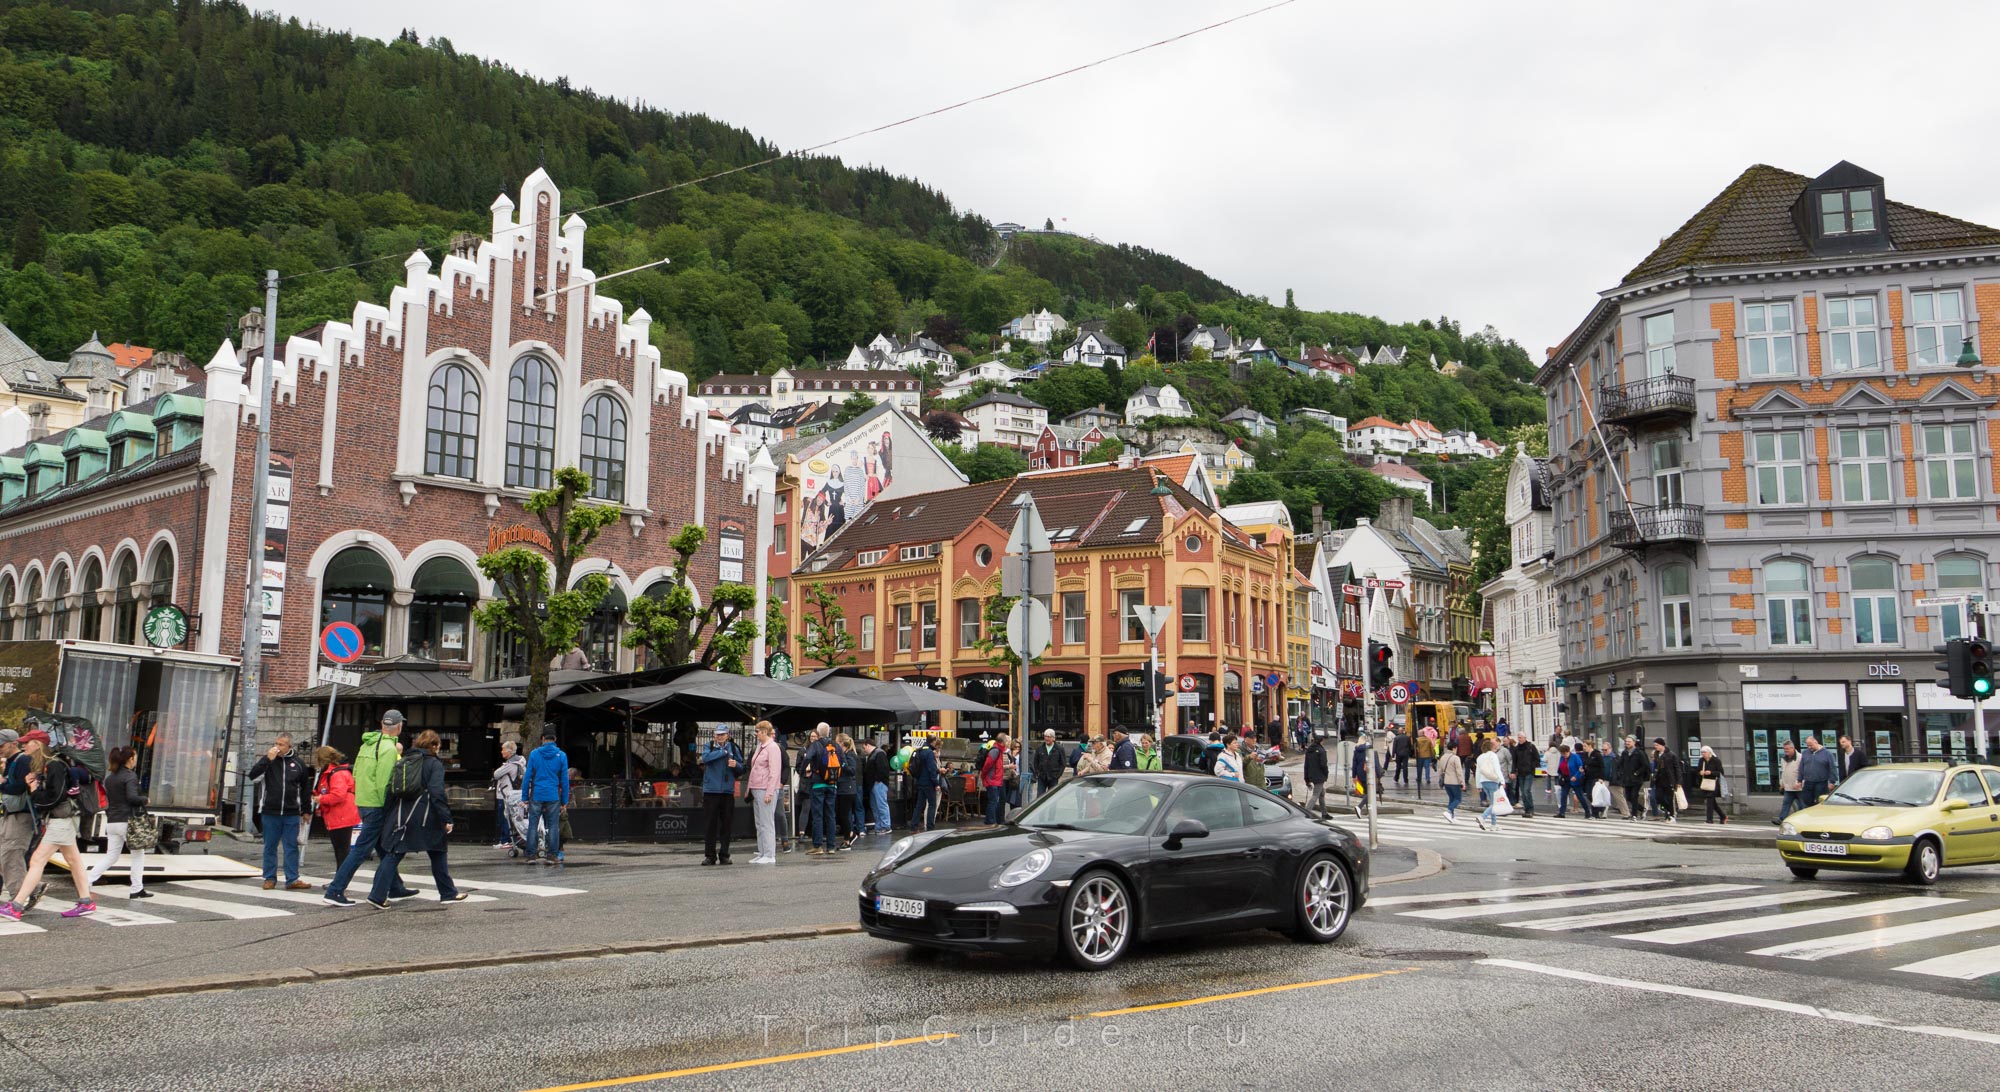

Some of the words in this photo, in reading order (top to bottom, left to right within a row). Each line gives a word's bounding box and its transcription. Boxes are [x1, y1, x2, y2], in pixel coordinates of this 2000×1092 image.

[825, 445, 842, 459] Come
[842, 439, 854, 449] and
[853, 430, 868, 445] party
[868, 423, 880, 434] with
[880, 416, 889, 427] us!
[268, 486, 286, 497] AR
[723, 546, 741, 557] BAR
[722, 569, 741, 579] 1877
[1868, 662, 1901, 677] DNB
[1042, 677, 1063, 686] ANNE
[1119, 676, 1141, 685] ANNE
[1392, 688, 1406, 699] 30
[655, 820, 688, 830] EGON
[880, 898, 892, 910] KH
[894, 900, 923, 914] 92069
